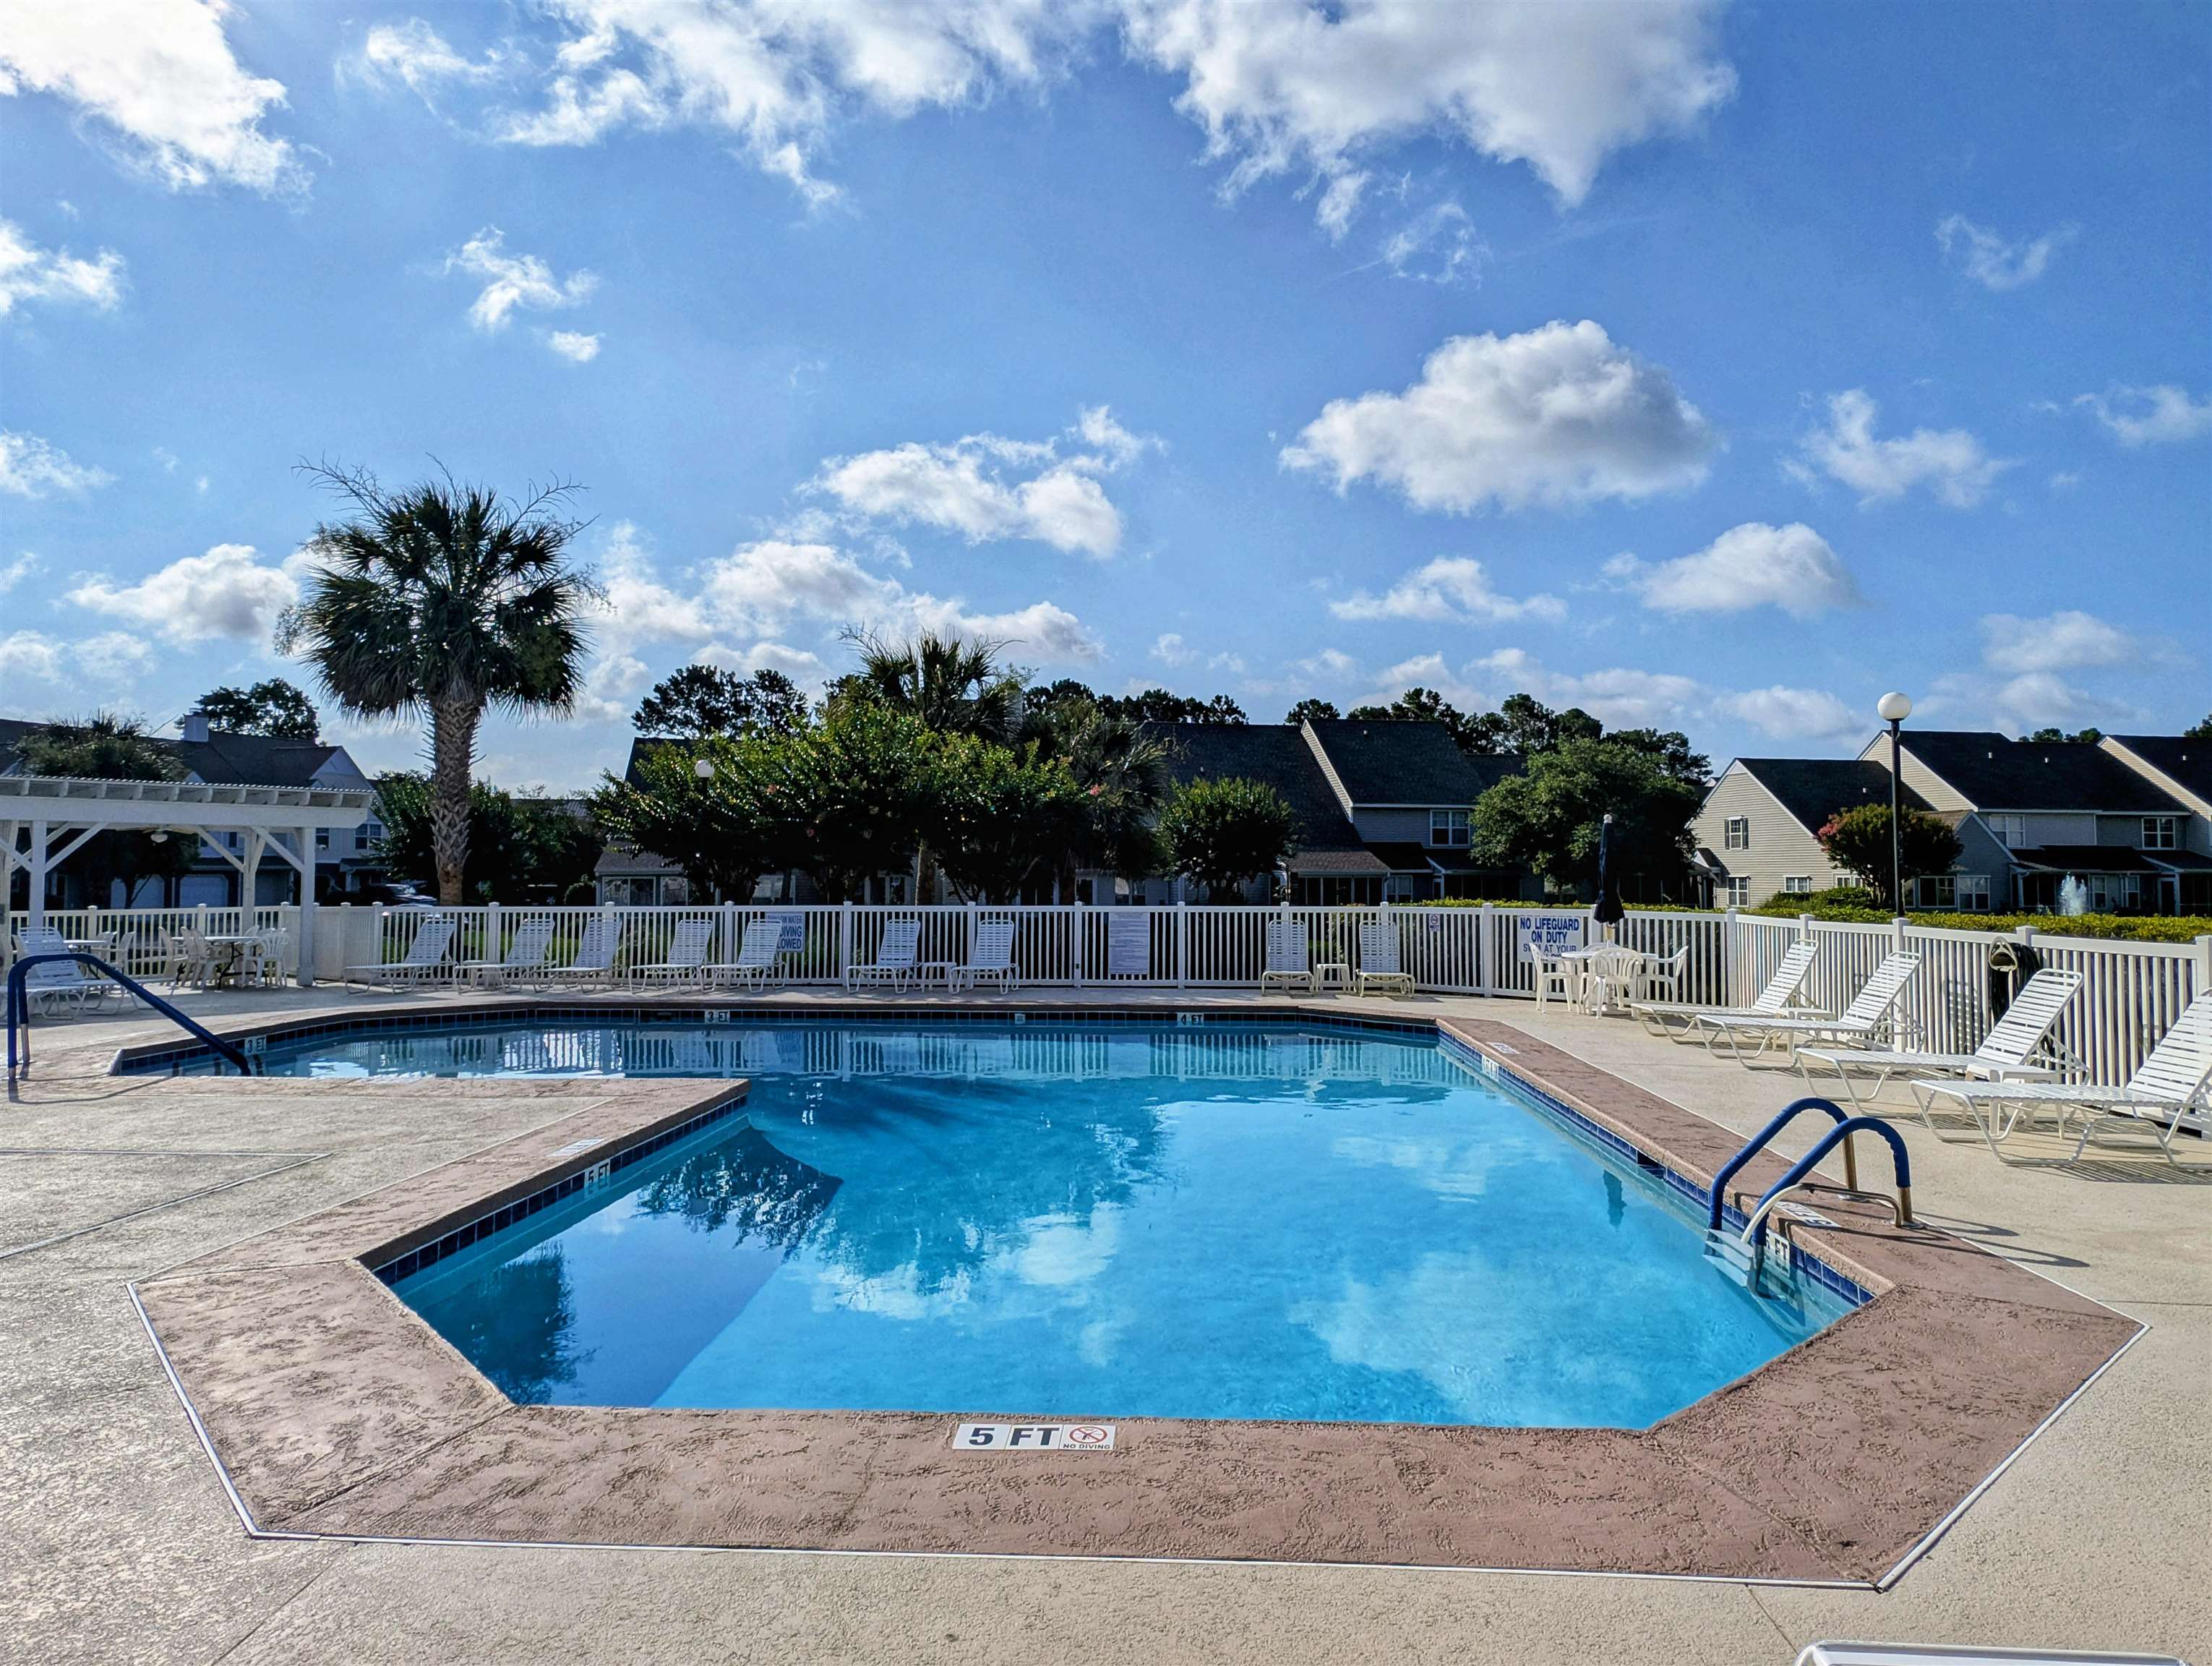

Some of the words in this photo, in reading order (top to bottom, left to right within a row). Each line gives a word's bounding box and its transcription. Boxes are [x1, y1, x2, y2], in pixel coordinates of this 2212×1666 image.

[1520, 917, 1531, 930] NO
[1535, 918, 1579, 931] LIFEGUARD
[776, 939, 802, 949] LOWED
[1532, 931, 1542, 942] ON
[1547, 931, 1567, 944] DUTY
[969, 1427, 995, 1445] 5
[1010, 1427, 1060, 1445] FT
